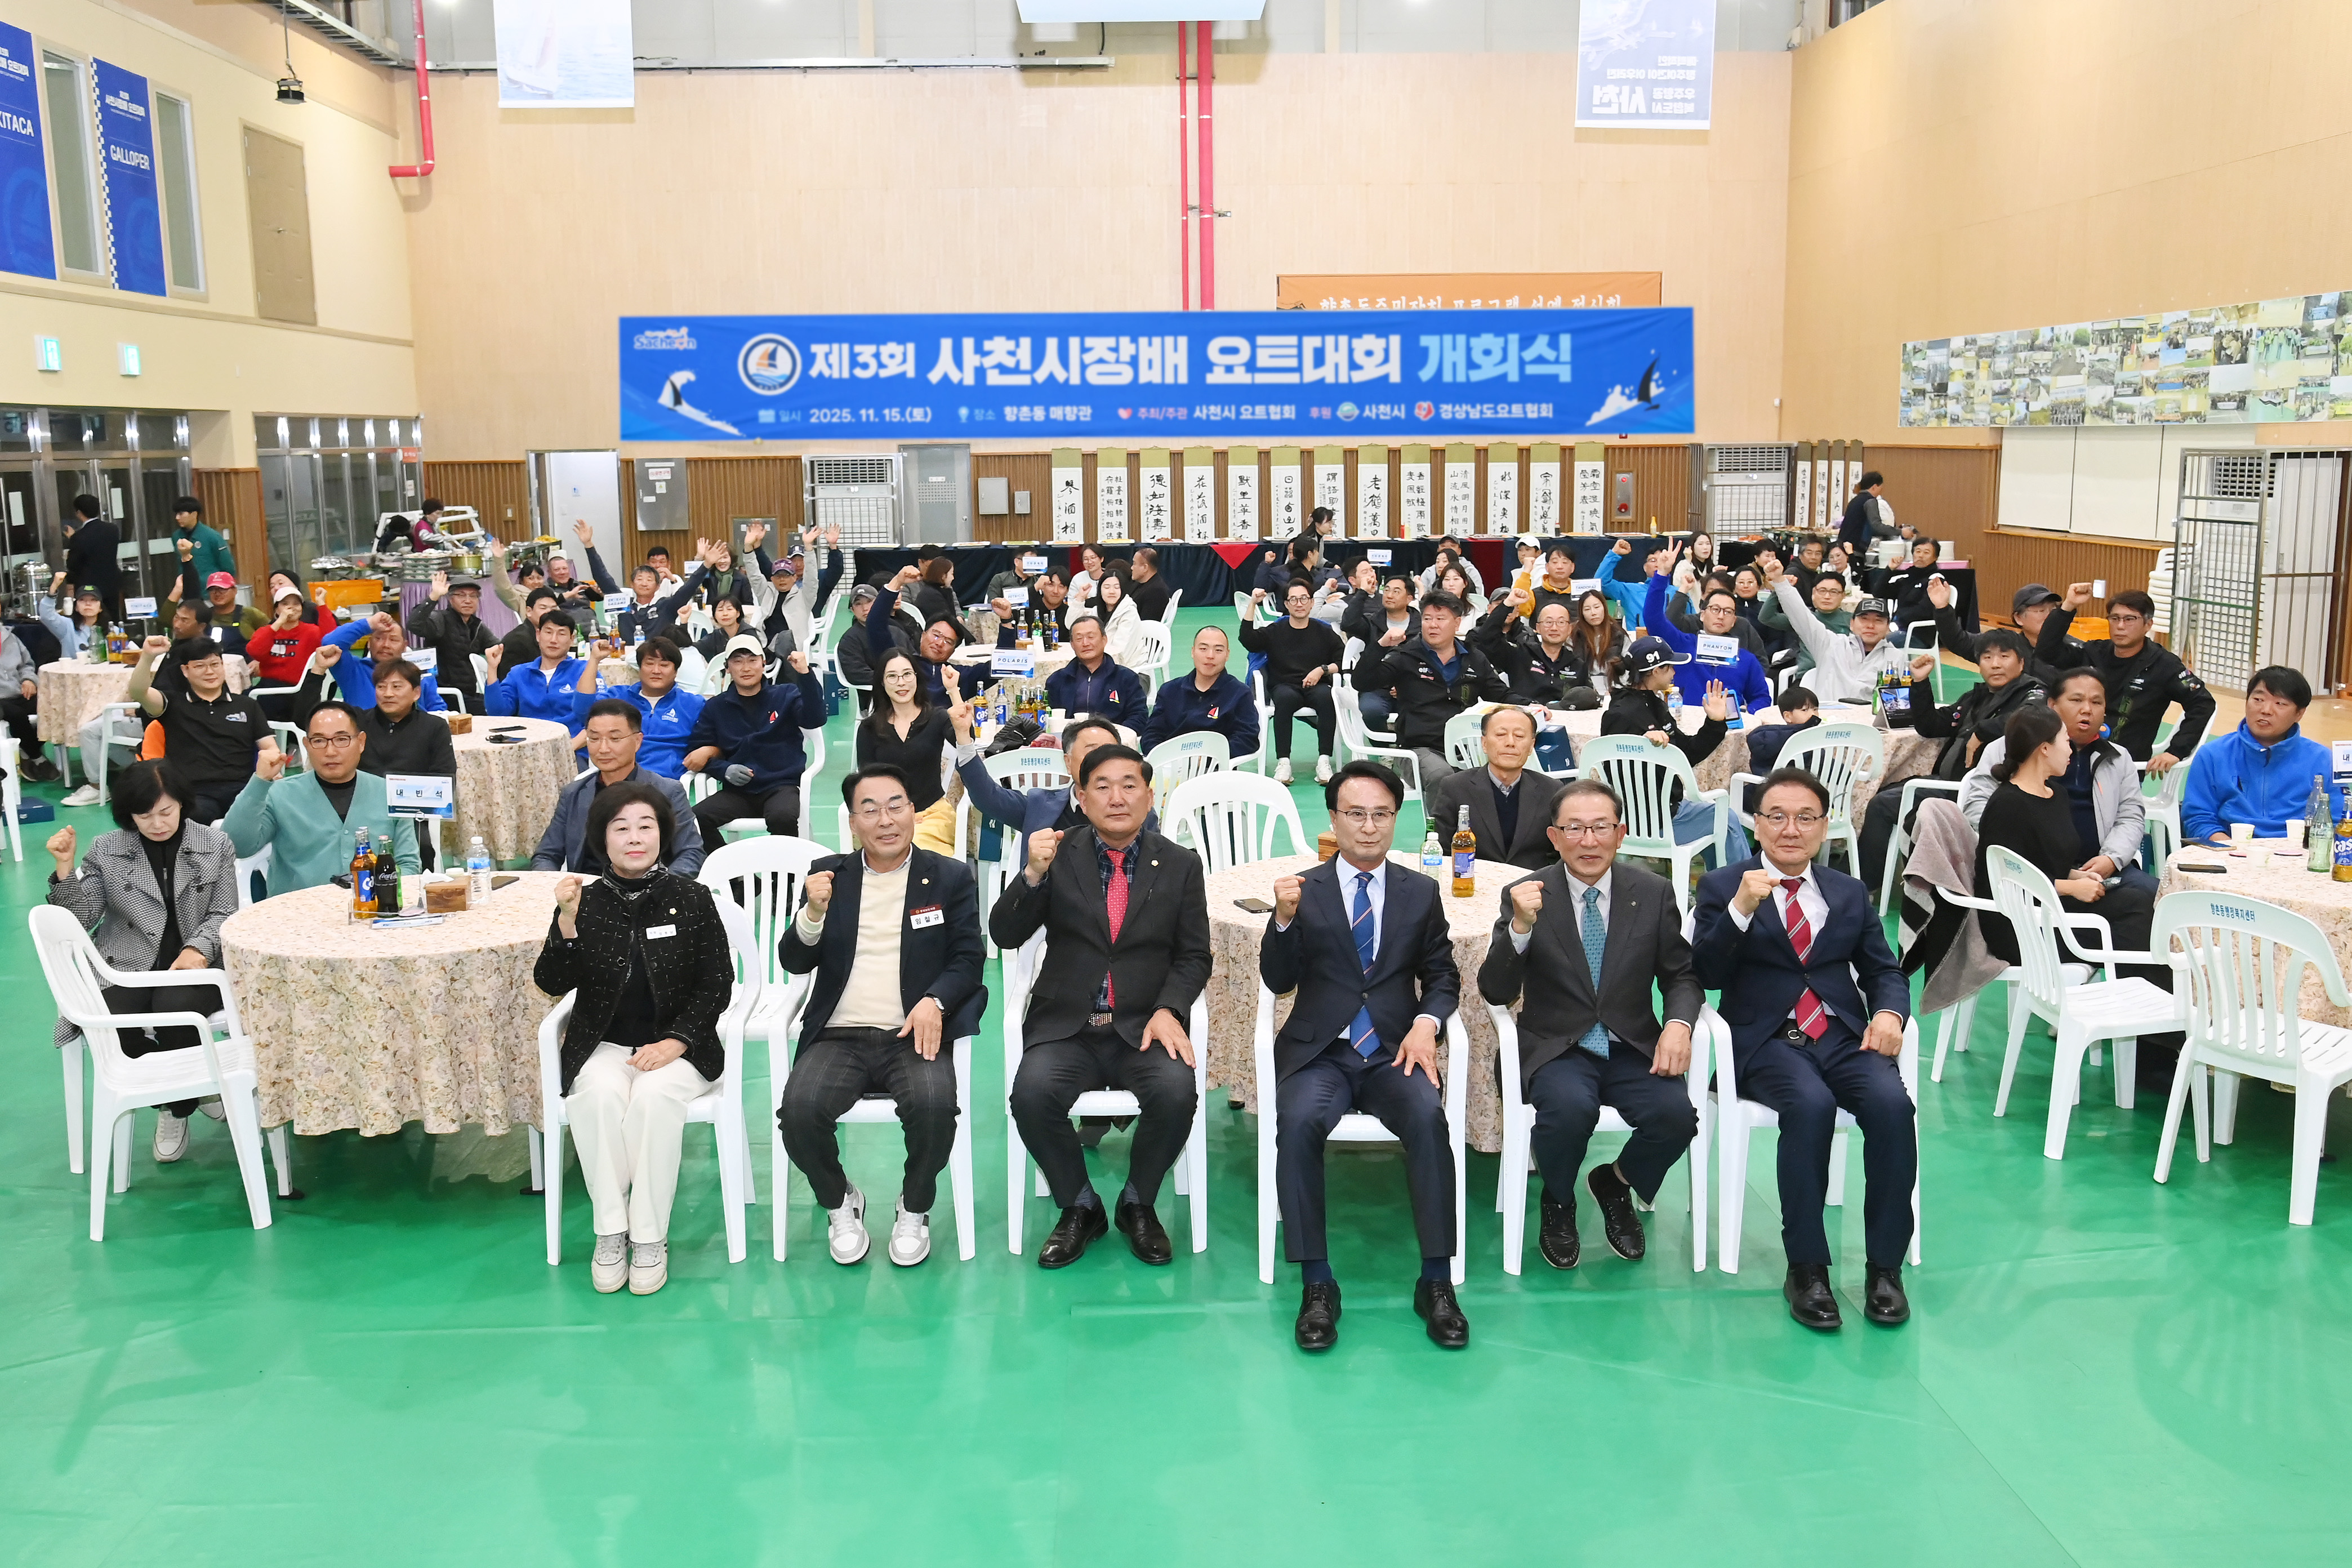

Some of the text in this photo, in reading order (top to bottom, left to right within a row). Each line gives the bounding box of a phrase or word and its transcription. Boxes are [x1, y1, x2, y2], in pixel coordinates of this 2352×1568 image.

[110, 144, 150, 171] GALLOPER
[809, 333, 1571, 385] 제3회 사천시장배 요트대회 개회식
[778, 406, 932, 423] 일시 2025. 11. 15.(토)
[973, 405, 1093, 421] 장소 향촌동 매향관
[1138, 404, 1296, 420] 주최/주관 사천시 요트협회
[1309, 404, 1406, 420] 후원 사천시
[1439, 403, 1554, 420] 경상남도요트협회
[1646, 651, 1661, 663] 91
[2210, 902, 2256, 923] 향촌동행정복지센터
